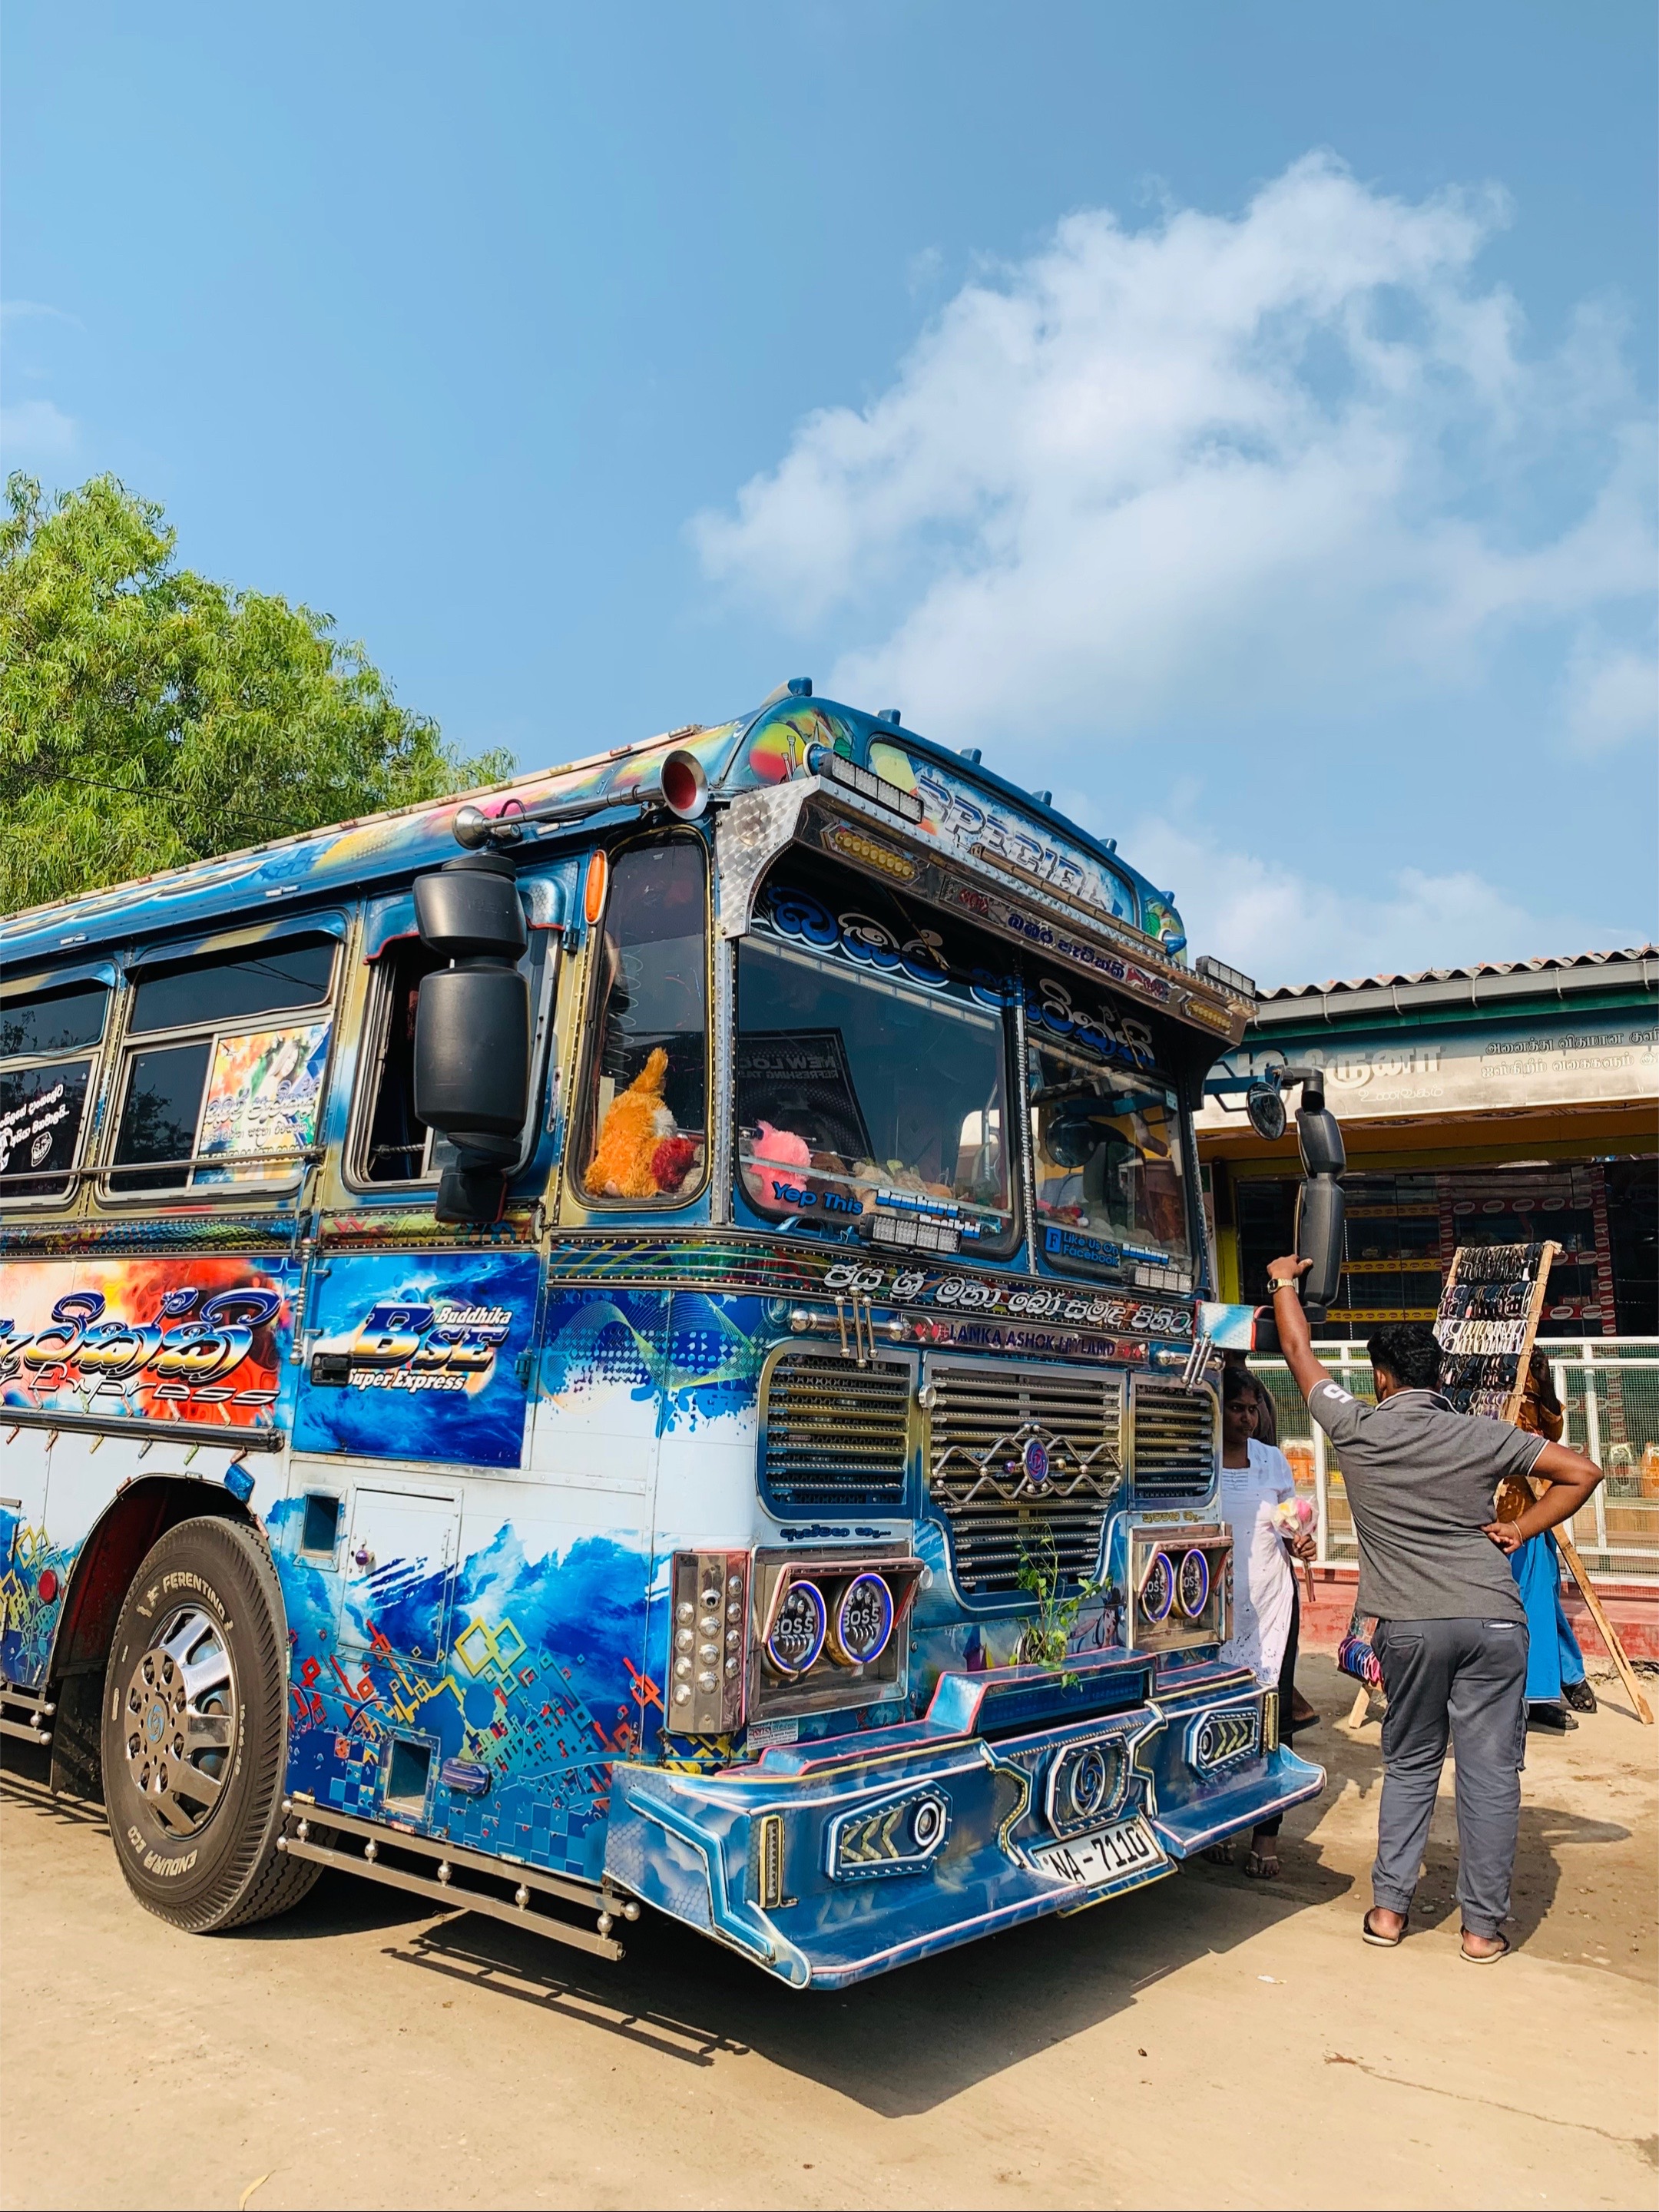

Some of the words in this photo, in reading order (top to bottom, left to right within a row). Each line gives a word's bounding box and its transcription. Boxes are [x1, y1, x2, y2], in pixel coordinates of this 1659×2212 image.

[1558, 1033, 1624, 1051] விதமான
[1358, 1084, 1443, 1102] உணவகம்
[773, 1181, 817, 1208] Yep
[823, 1191, 863, 1215] This
[1063, 1232, 1086, 1247] Like
[1088, 1239, 1101, 1250] Us
[1102, 1242, 1120, 1255] On
[1063, 1244, 1121, 1268] Facebook
[823, 1262, 885, 1291] ජය
[935, 1276, 1002, 1309] මහා
[435, 1306, 513, 1325] Buddhika
[950, 1323, 1002, 1344] LANKA
[1005, 1330, 1056, 1351] ASHOK
[28, 1361, 280, 1405] Express
[392, 1369, 466, 1394] Express
[1323, 1383, 1354, 1404] 5
[1146, 1580, 1165, 1593] OSS
[1183, 1576, 1199, 1588] OSS
[162, 1571, 226, 1621] FERENTINO
[127, 1825, 147, 1854] ECO
[144, 1849, 198, 1876] ENDURA
